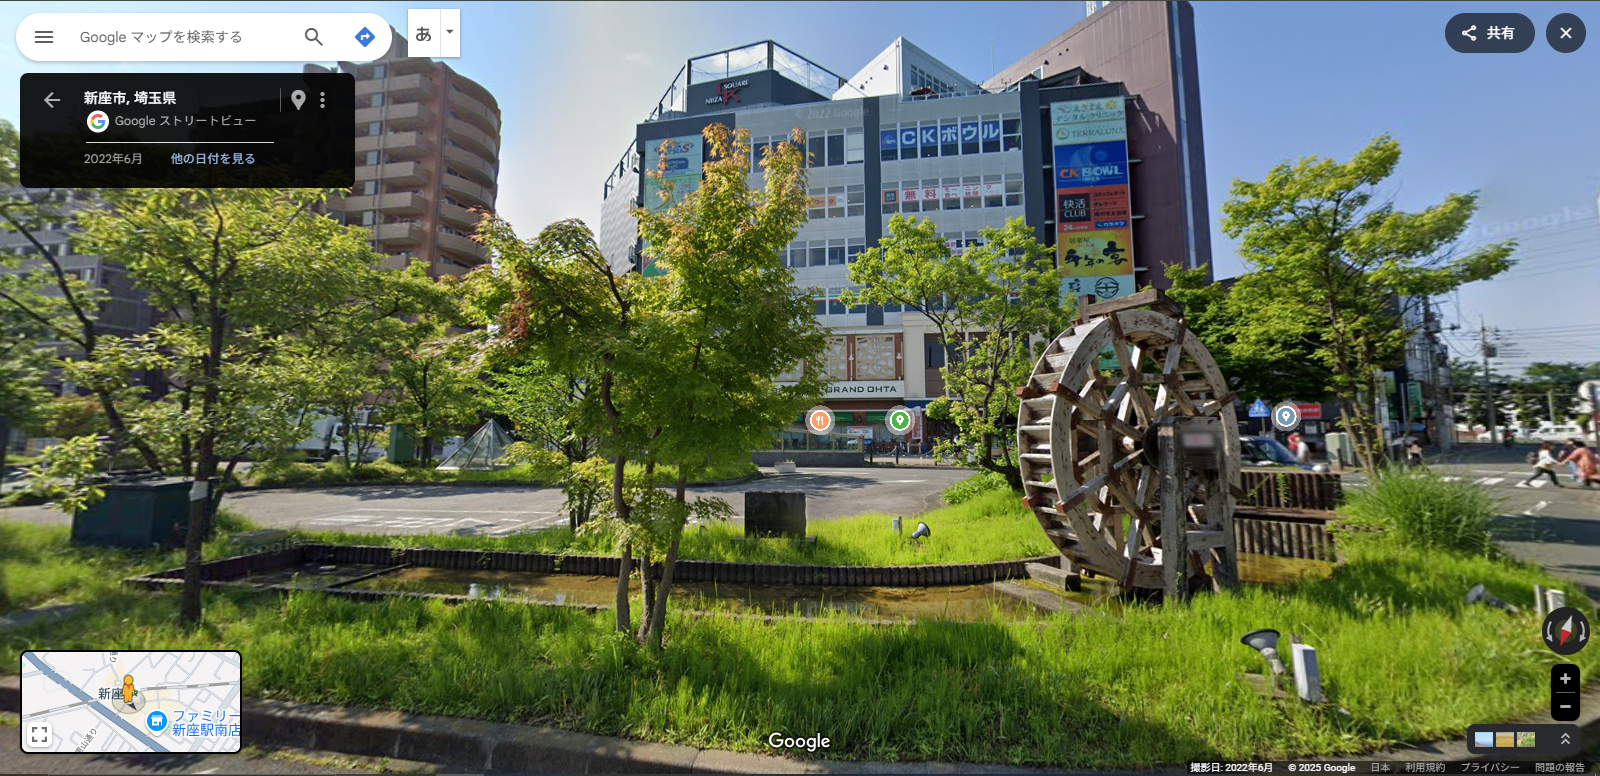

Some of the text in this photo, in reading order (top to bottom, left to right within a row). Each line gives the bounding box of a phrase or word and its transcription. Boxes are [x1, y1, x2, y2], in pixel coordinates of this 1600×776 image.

[723, 79, 749, 90] SQUARE
[705, 95, 723, 105] NIIZA
[900, 122, 1001, 146] CKボウル
[1071, 127, 1125, 138] TERRALUNA
[1059, 164, 1124, 179] CK BOWL
[904, 188, 937, 201] 無料
[1063, 198, 1086, 210] 快活
[1063, 210, 1087, 218] CLUB
[867, 385, 897, 393] OHTA
